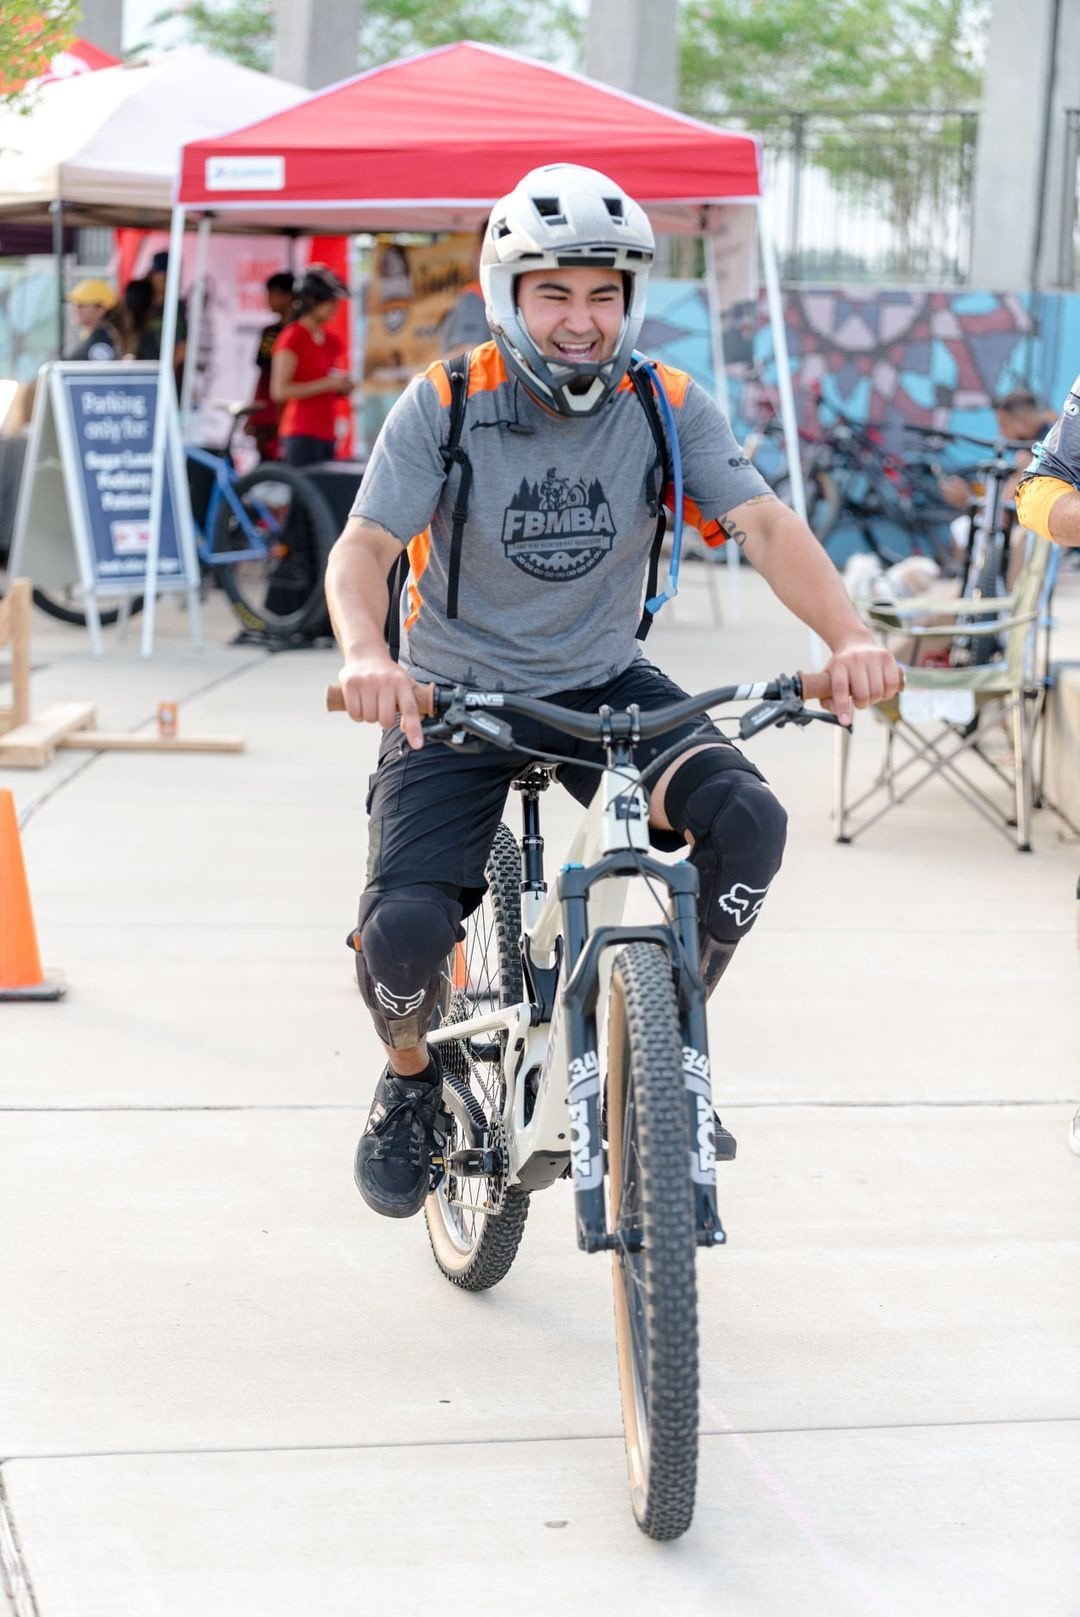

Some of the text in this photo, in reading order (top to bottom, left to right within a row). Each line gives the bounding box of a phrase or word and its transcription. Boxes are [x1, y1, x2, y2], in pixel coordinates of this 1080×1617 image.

[82, 391, 147, 418] Parking
[85, 416, 122, 443] only
[502, 501, 616, 542] FBMBA
[568, 1050, 600, 1083] 34
[681, 1046, 711, 1078] 34
[568, 1099, 592, 1178] FOX
[696, 1095, 716, 1173] FOX
